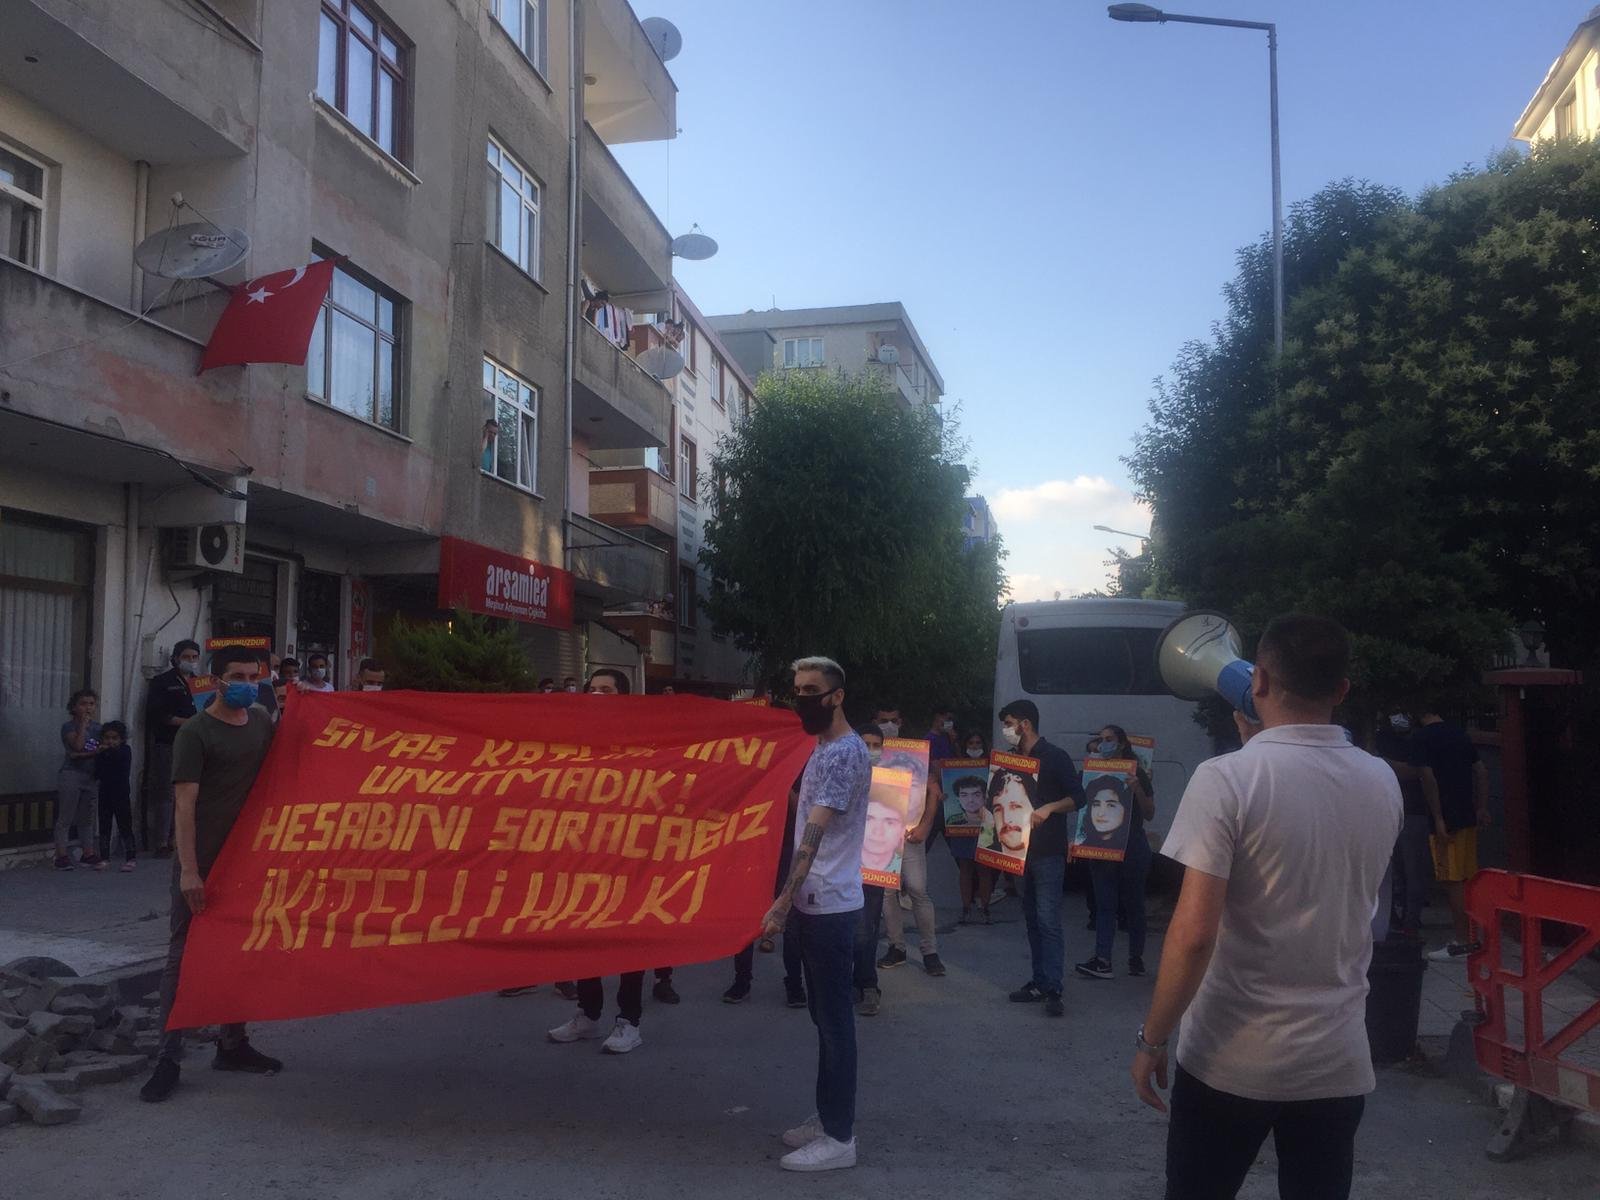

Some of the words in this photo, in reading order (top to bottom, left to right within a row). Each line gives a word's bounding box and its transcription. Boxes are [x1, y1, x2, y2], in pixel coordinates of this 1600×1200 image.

[486, 564, 548, 607] arsamiea
[312, 717, 457, 762] SİVAS
[251, 802, 473, 851] HESABINI
[502, 864, 712, 934] HALKI
